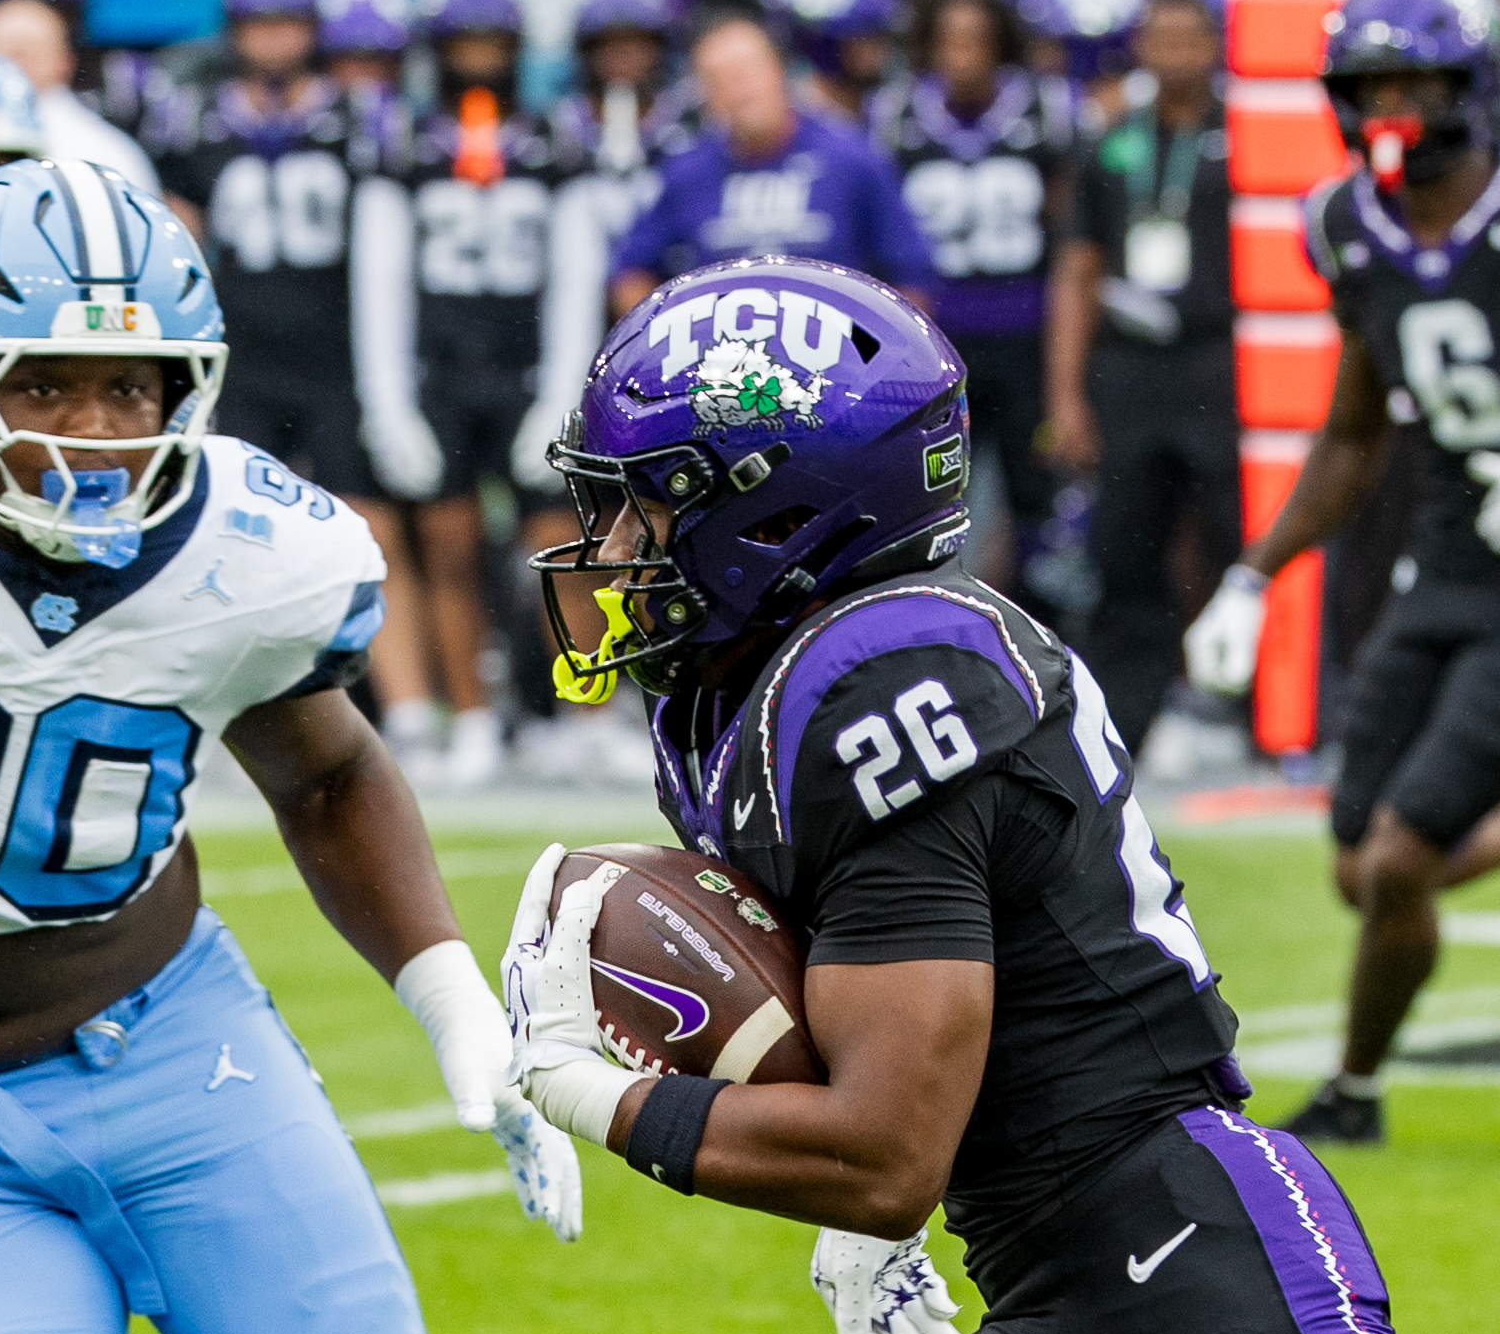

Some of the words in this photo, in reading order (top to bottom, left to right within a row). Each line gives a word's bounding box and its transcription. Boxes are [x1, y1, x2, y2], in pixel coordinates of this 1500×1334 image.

[210, 150, 351, 272] 40
[85, 306, 137, 330] UNC
[649, 287, 853, 381] TCU
[833, 678, 979, 822] 26
[637, 892, 686, 932] ELITE
[682, 925, 735, 982] VAPOR
